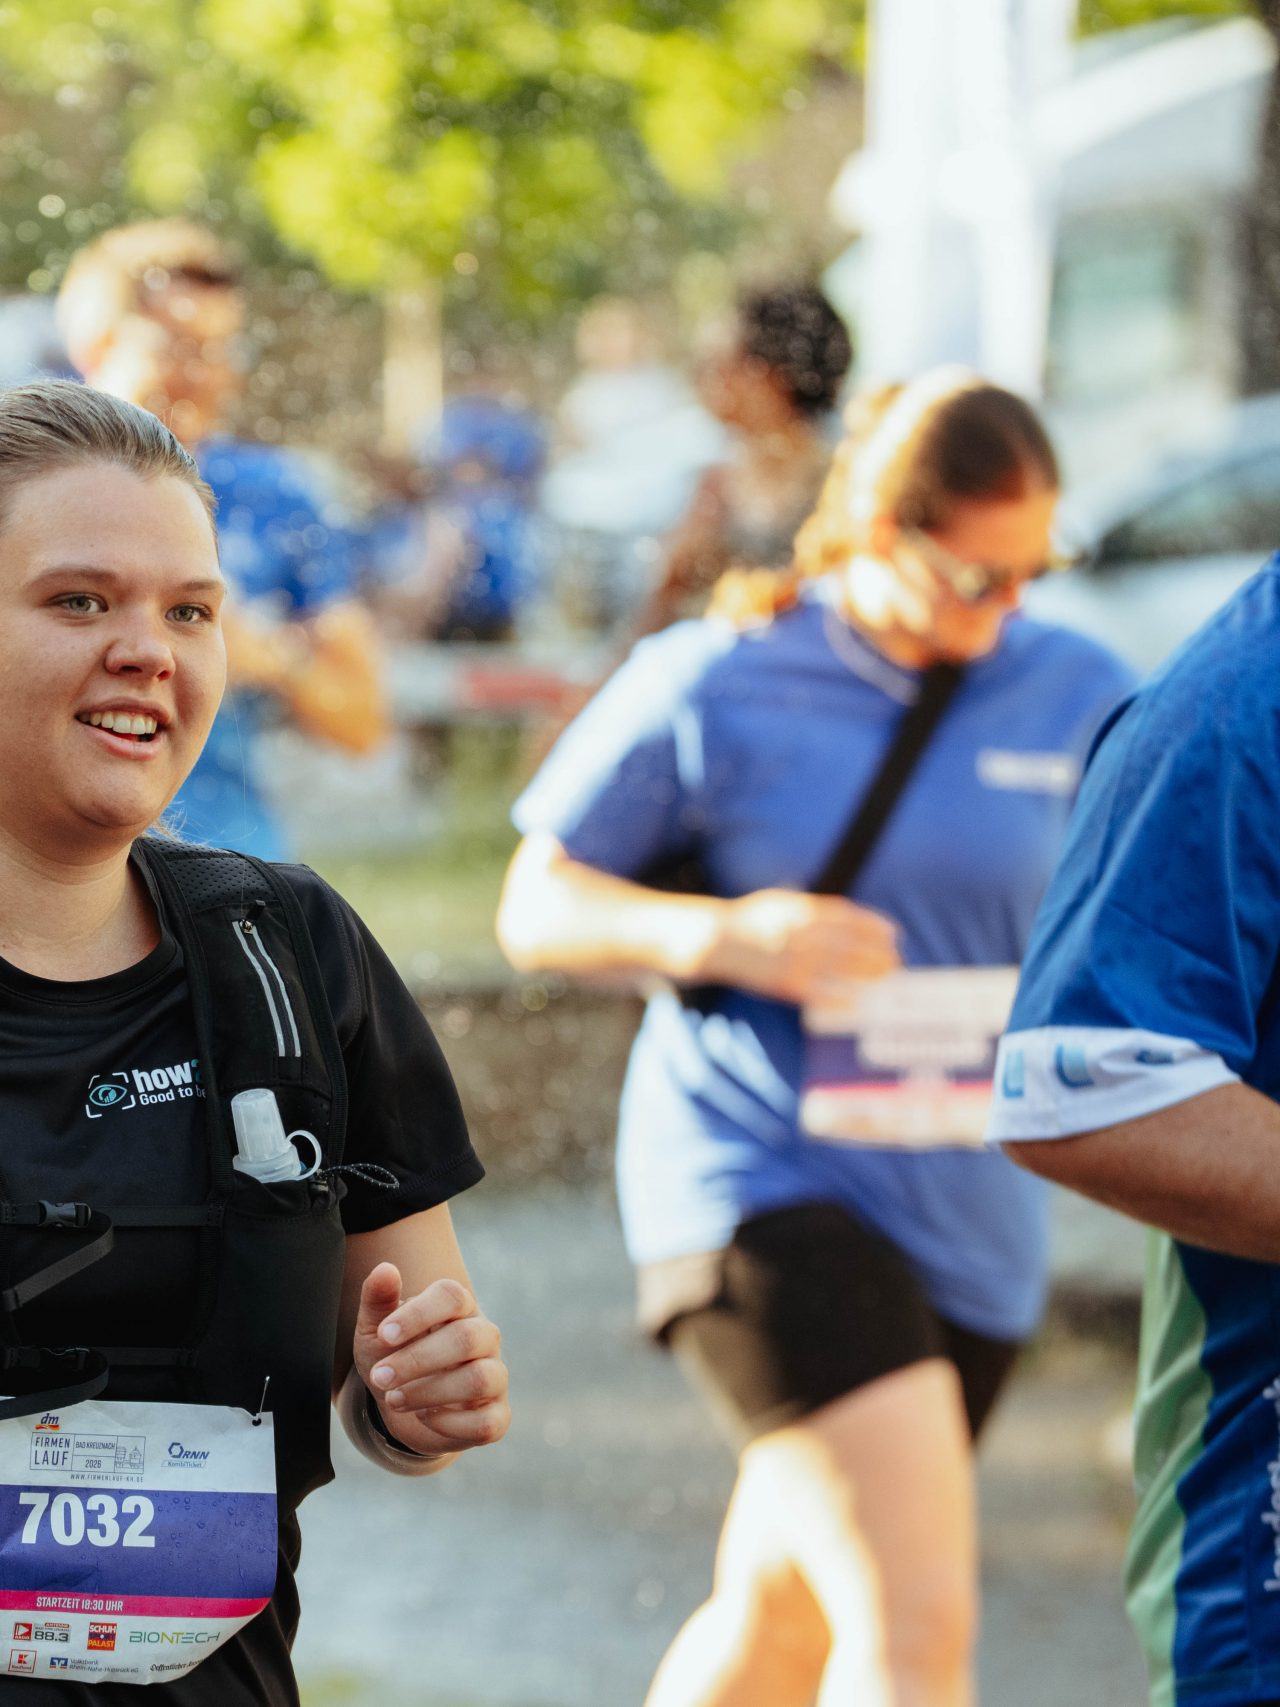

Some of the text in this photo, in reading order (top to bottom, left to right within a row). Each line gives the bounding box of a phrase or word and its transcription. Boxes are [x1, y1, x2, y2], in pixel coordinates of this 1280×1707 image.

[139, 1089, 175, 1105] Good
[178, 1086, 193, 1098] to
[41, 1412, 59, 1425] dm
[35, 1436, 70, 1449] FIRMEN
[34, 1450, 69, 1466] LAUF
[84, 1458, 103, 1469] 2026
[19, 1492, 155, 1548] 7032
[36, 1596, 124, 1612] STARTZEIT 18:30 UHR
[89, 1624, 117, 1634] SCHUH
[34, 1631, 69, 1642] 88.3
[129, 1631, 221, 1644] BIONTECH
[87, 1639, 115, 1648] PALAST
